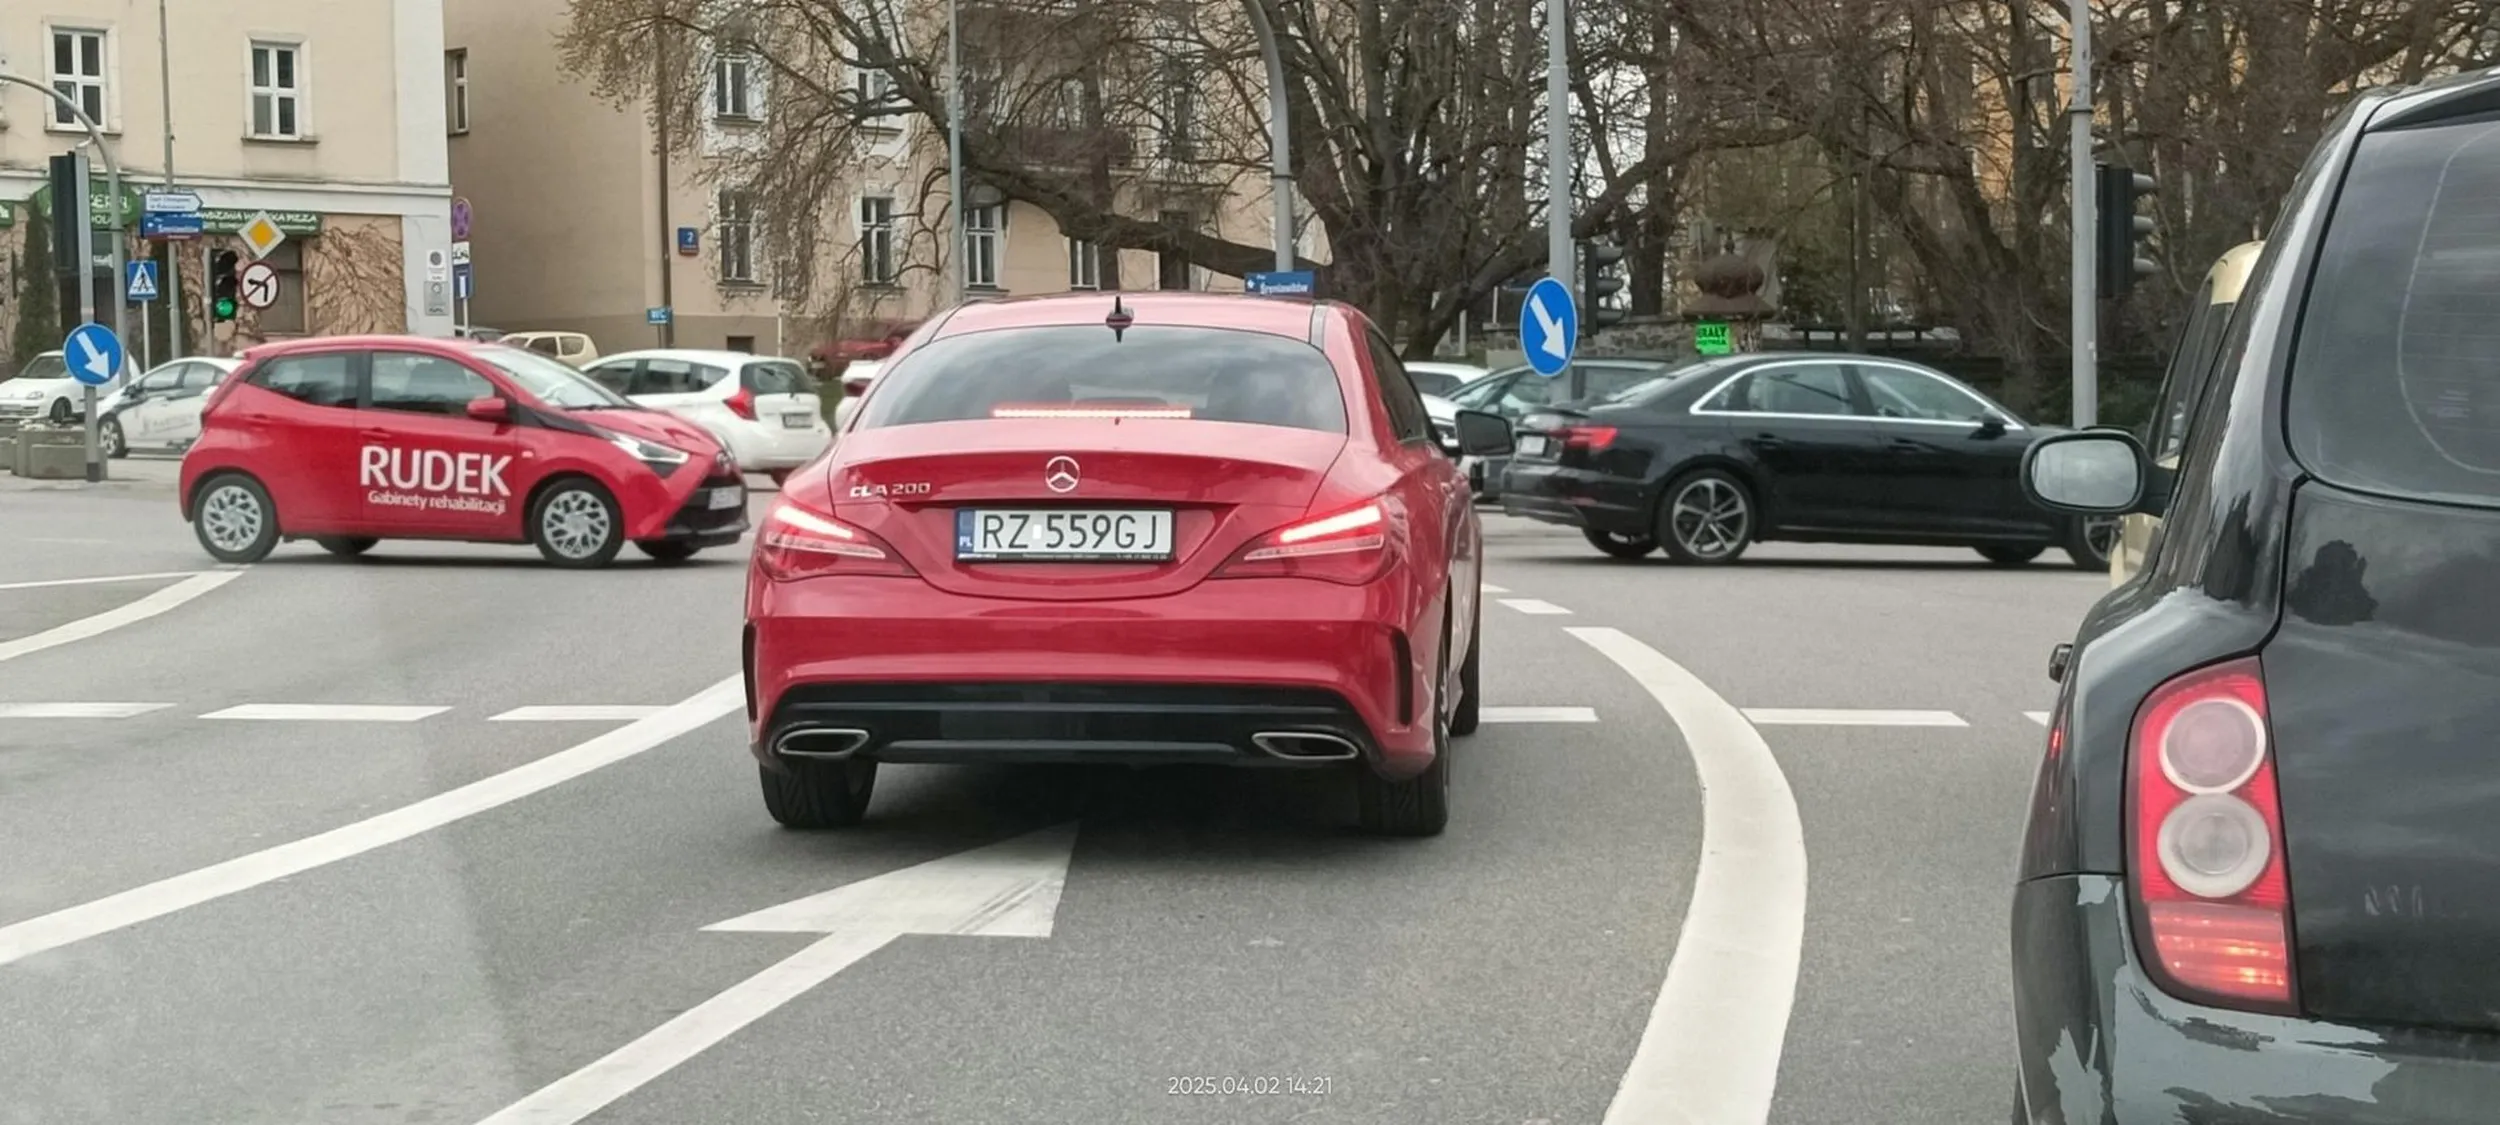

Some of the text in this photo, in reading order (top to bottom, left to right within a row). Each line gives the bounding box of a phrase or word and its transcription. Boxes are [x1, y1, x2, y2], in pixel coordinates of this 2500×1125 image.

[360, 445, 513, 497] RUDEK
[368, 490, 506, 515] Gabinety rehabilitacji
[849, 482, 931, 498] CLA 200
[959, 535, 973, 547] PL
[982, 514, 1157, 549] RZ 559GJ
